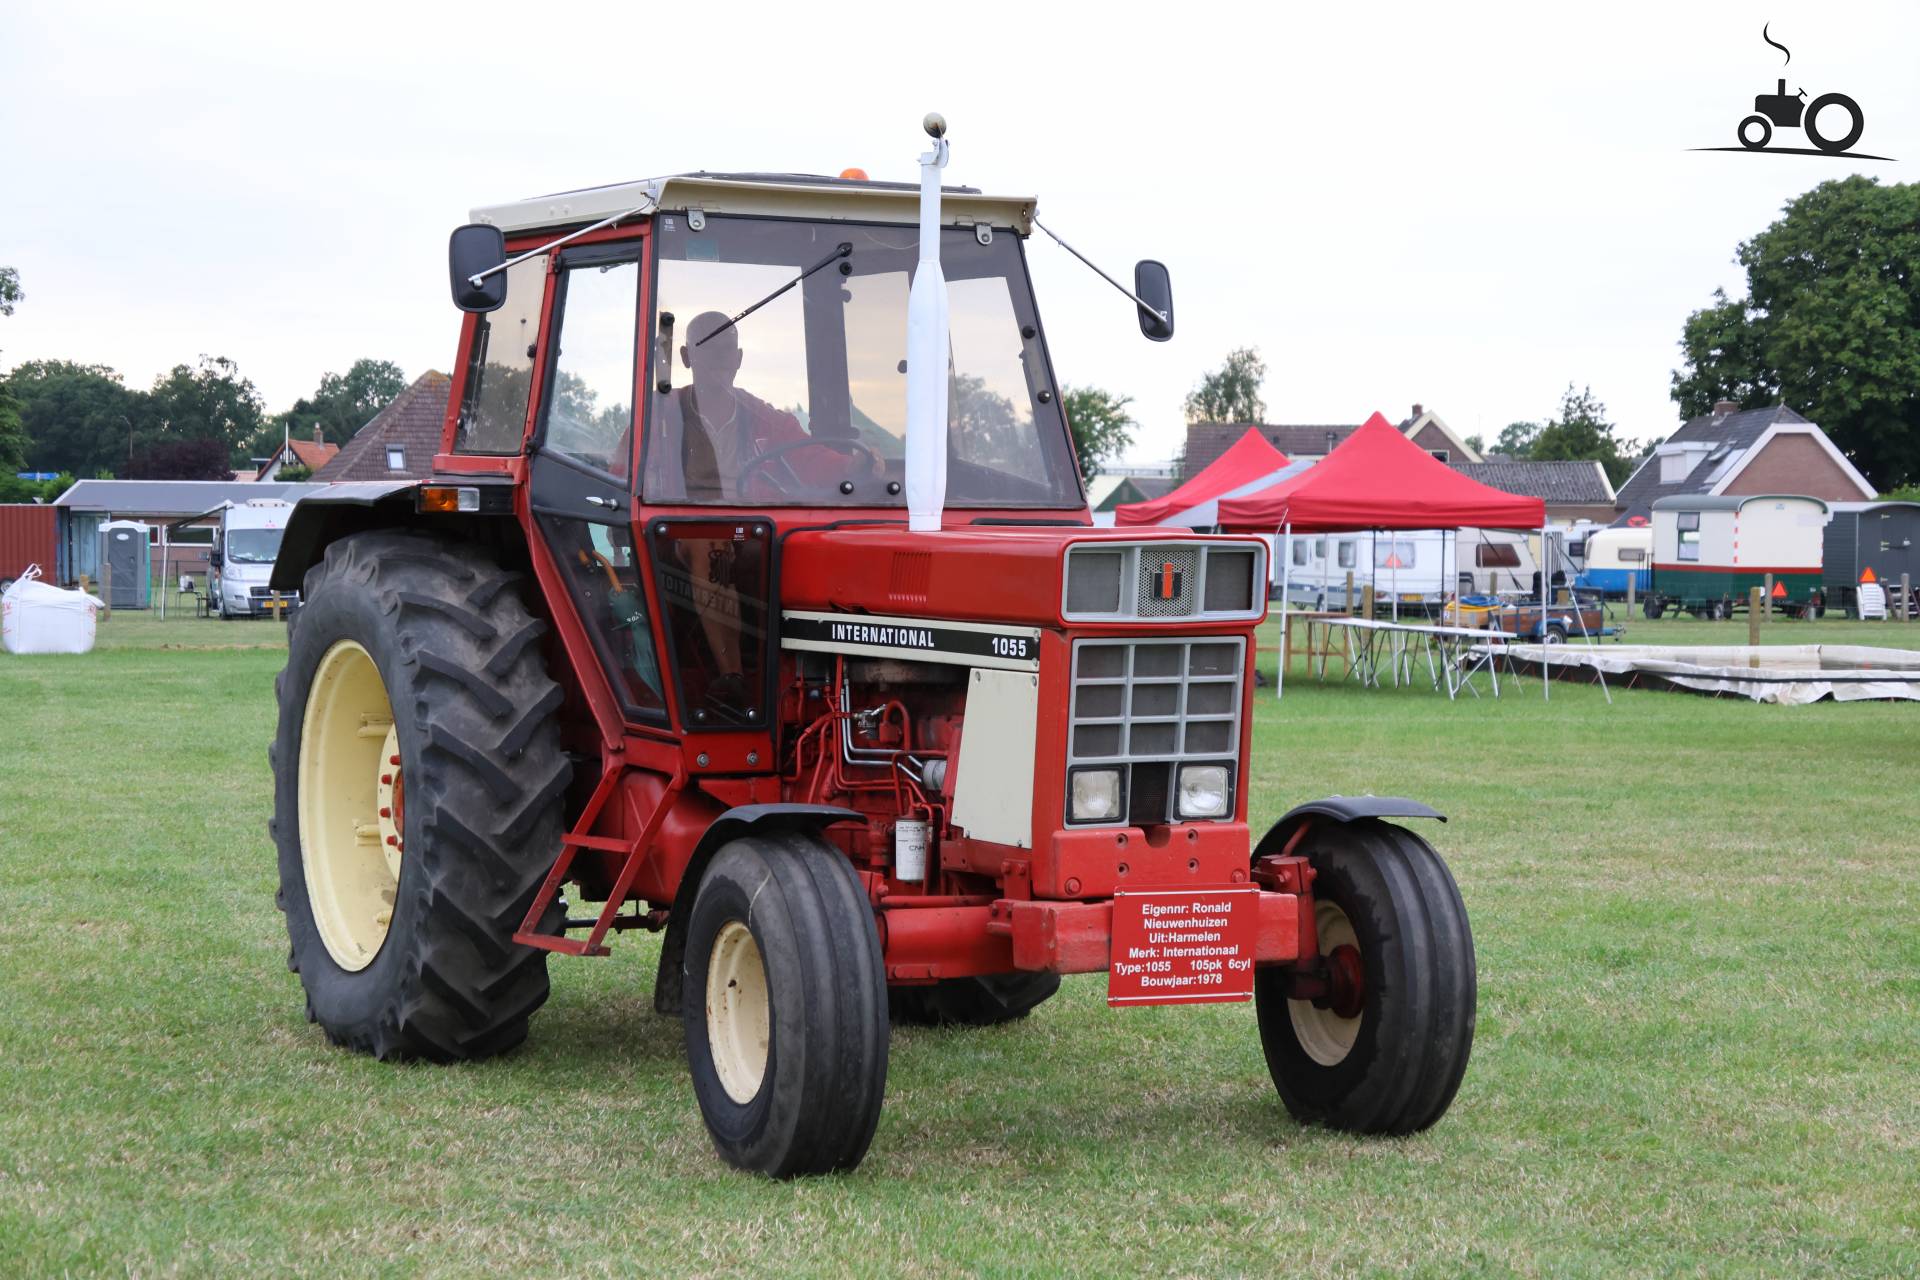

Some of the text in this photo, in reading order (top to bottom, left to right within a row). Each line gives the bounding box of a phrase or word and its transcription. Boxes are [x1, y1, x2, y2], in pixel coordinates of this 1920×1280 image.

[831, 623, 1027, 657] INTERNATIONAL 1055
[1142, 902, 1232, 917] Eigennr: Ronald
[1143, 917, 1228, 929] Nieuwenhuizen
[1149, 932, 1221, 944] Uit:Harmelen
[1129, 944, 1239, 959] Merk: Internationaal
[1115, 958, 1251, 976] Type:1055 105pk 6cyl
[1141, 973, 1223, 988] Bouwjaar:1978
